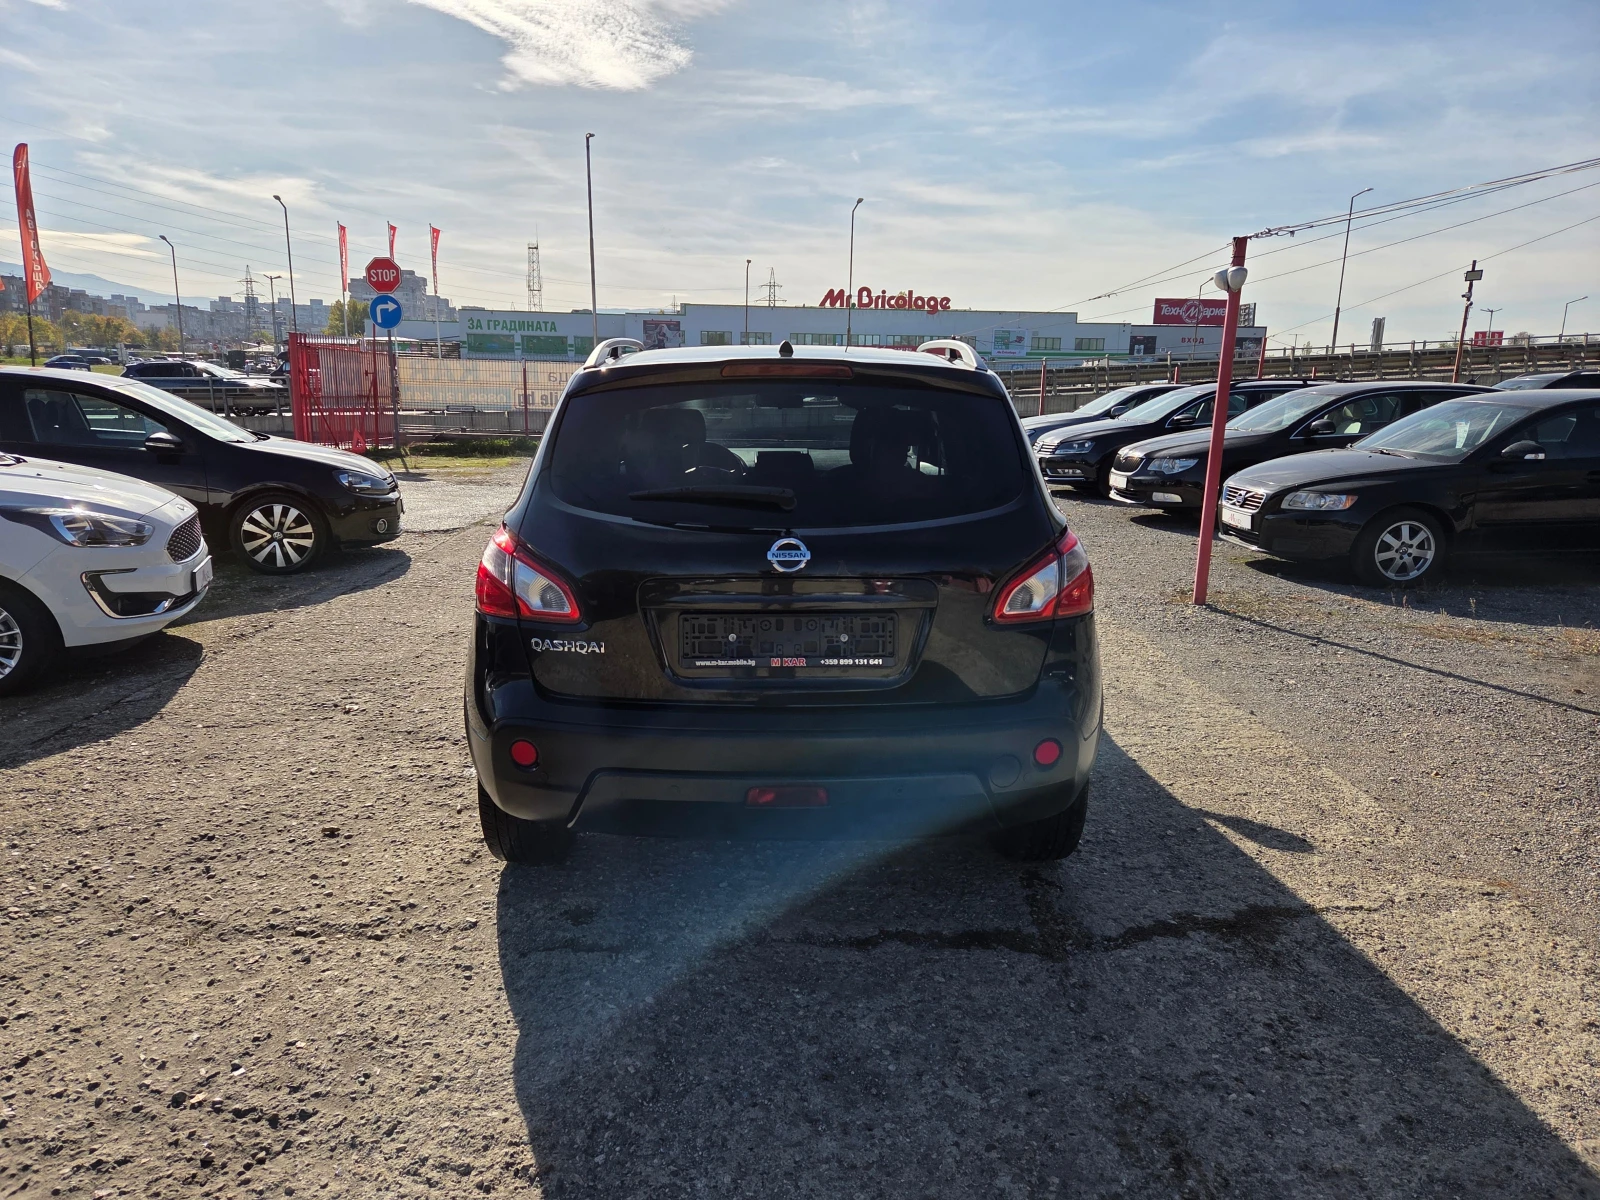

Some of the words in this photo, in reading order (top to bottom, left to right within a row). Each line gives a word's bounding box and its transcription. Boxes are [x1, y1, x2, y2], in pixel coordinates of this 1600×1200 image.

[26, 208, 44, 291] АВТОКЪЩА
[370, 269, 397, 281] STOP
[857, 286, 951, 315] Bricolage
[467, 317, 483, 330] ЗА
[487, 319, 557, 333] ГРАДИНАТА
[530, 637, 605, 655] QASHQAI
[695, 659, 756, 667] www.m-kar.mobile.bg
[770, 657, 781, 667] M
[782, 657, 807, 667] KAR
